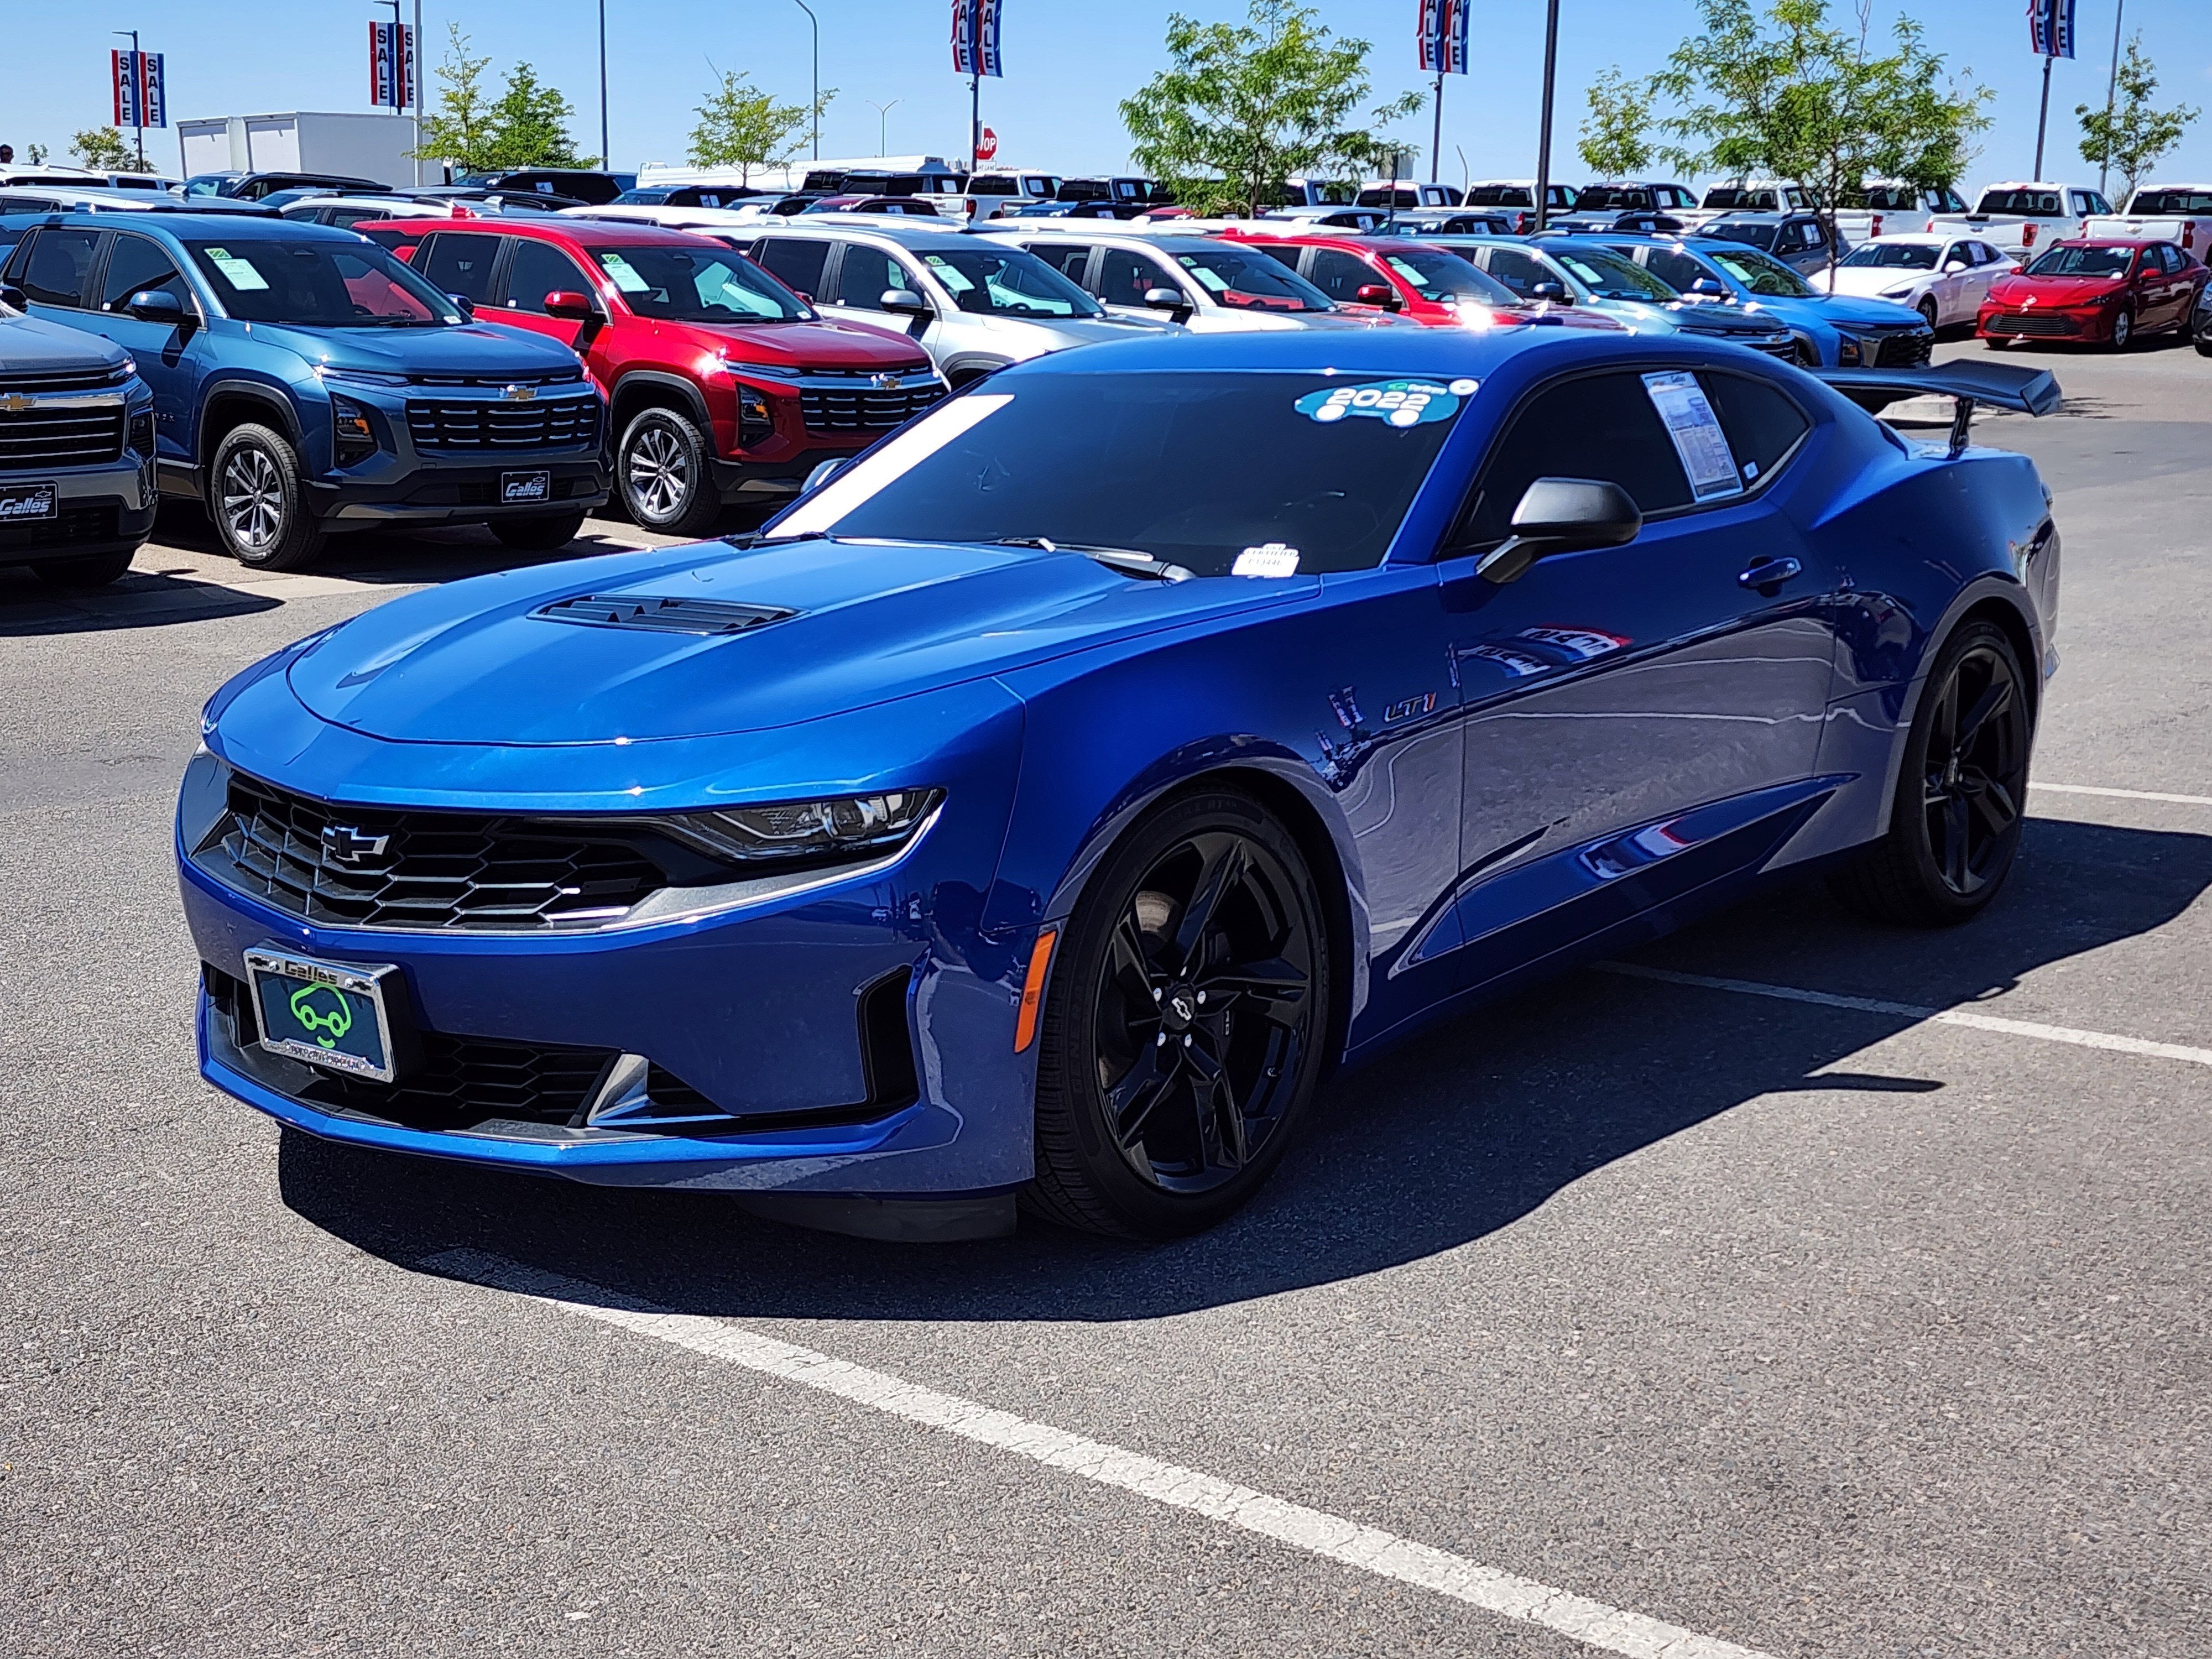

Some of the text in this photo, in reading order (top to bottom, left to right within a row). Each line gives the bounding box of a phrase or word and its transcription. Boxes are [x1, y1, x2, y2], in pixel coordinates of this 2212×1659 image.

[958, 0, 969, 65] ALE
[983, 0, 994, 69] ALE
[1426, 0, 1437, 62] ALE
[1452, 0, 1462, 65] ALE
[2036, 0, 2044, 44] LE
[2058, 0, 2067, 48] LE
[378, 29, 388, 99] SALE
[120, 57, 131, 121] SALE
[148, 59, 159, 122] SALE
[977, 137, 997, 151] OP
[1326, 388, 1431, 411] 2022
[0, 498, 51, 515] Galles
[505, 482, 545, 497] Galles
[1384, 692, 1436, 722] LT1
[285, 960, 338, 985] Galles
